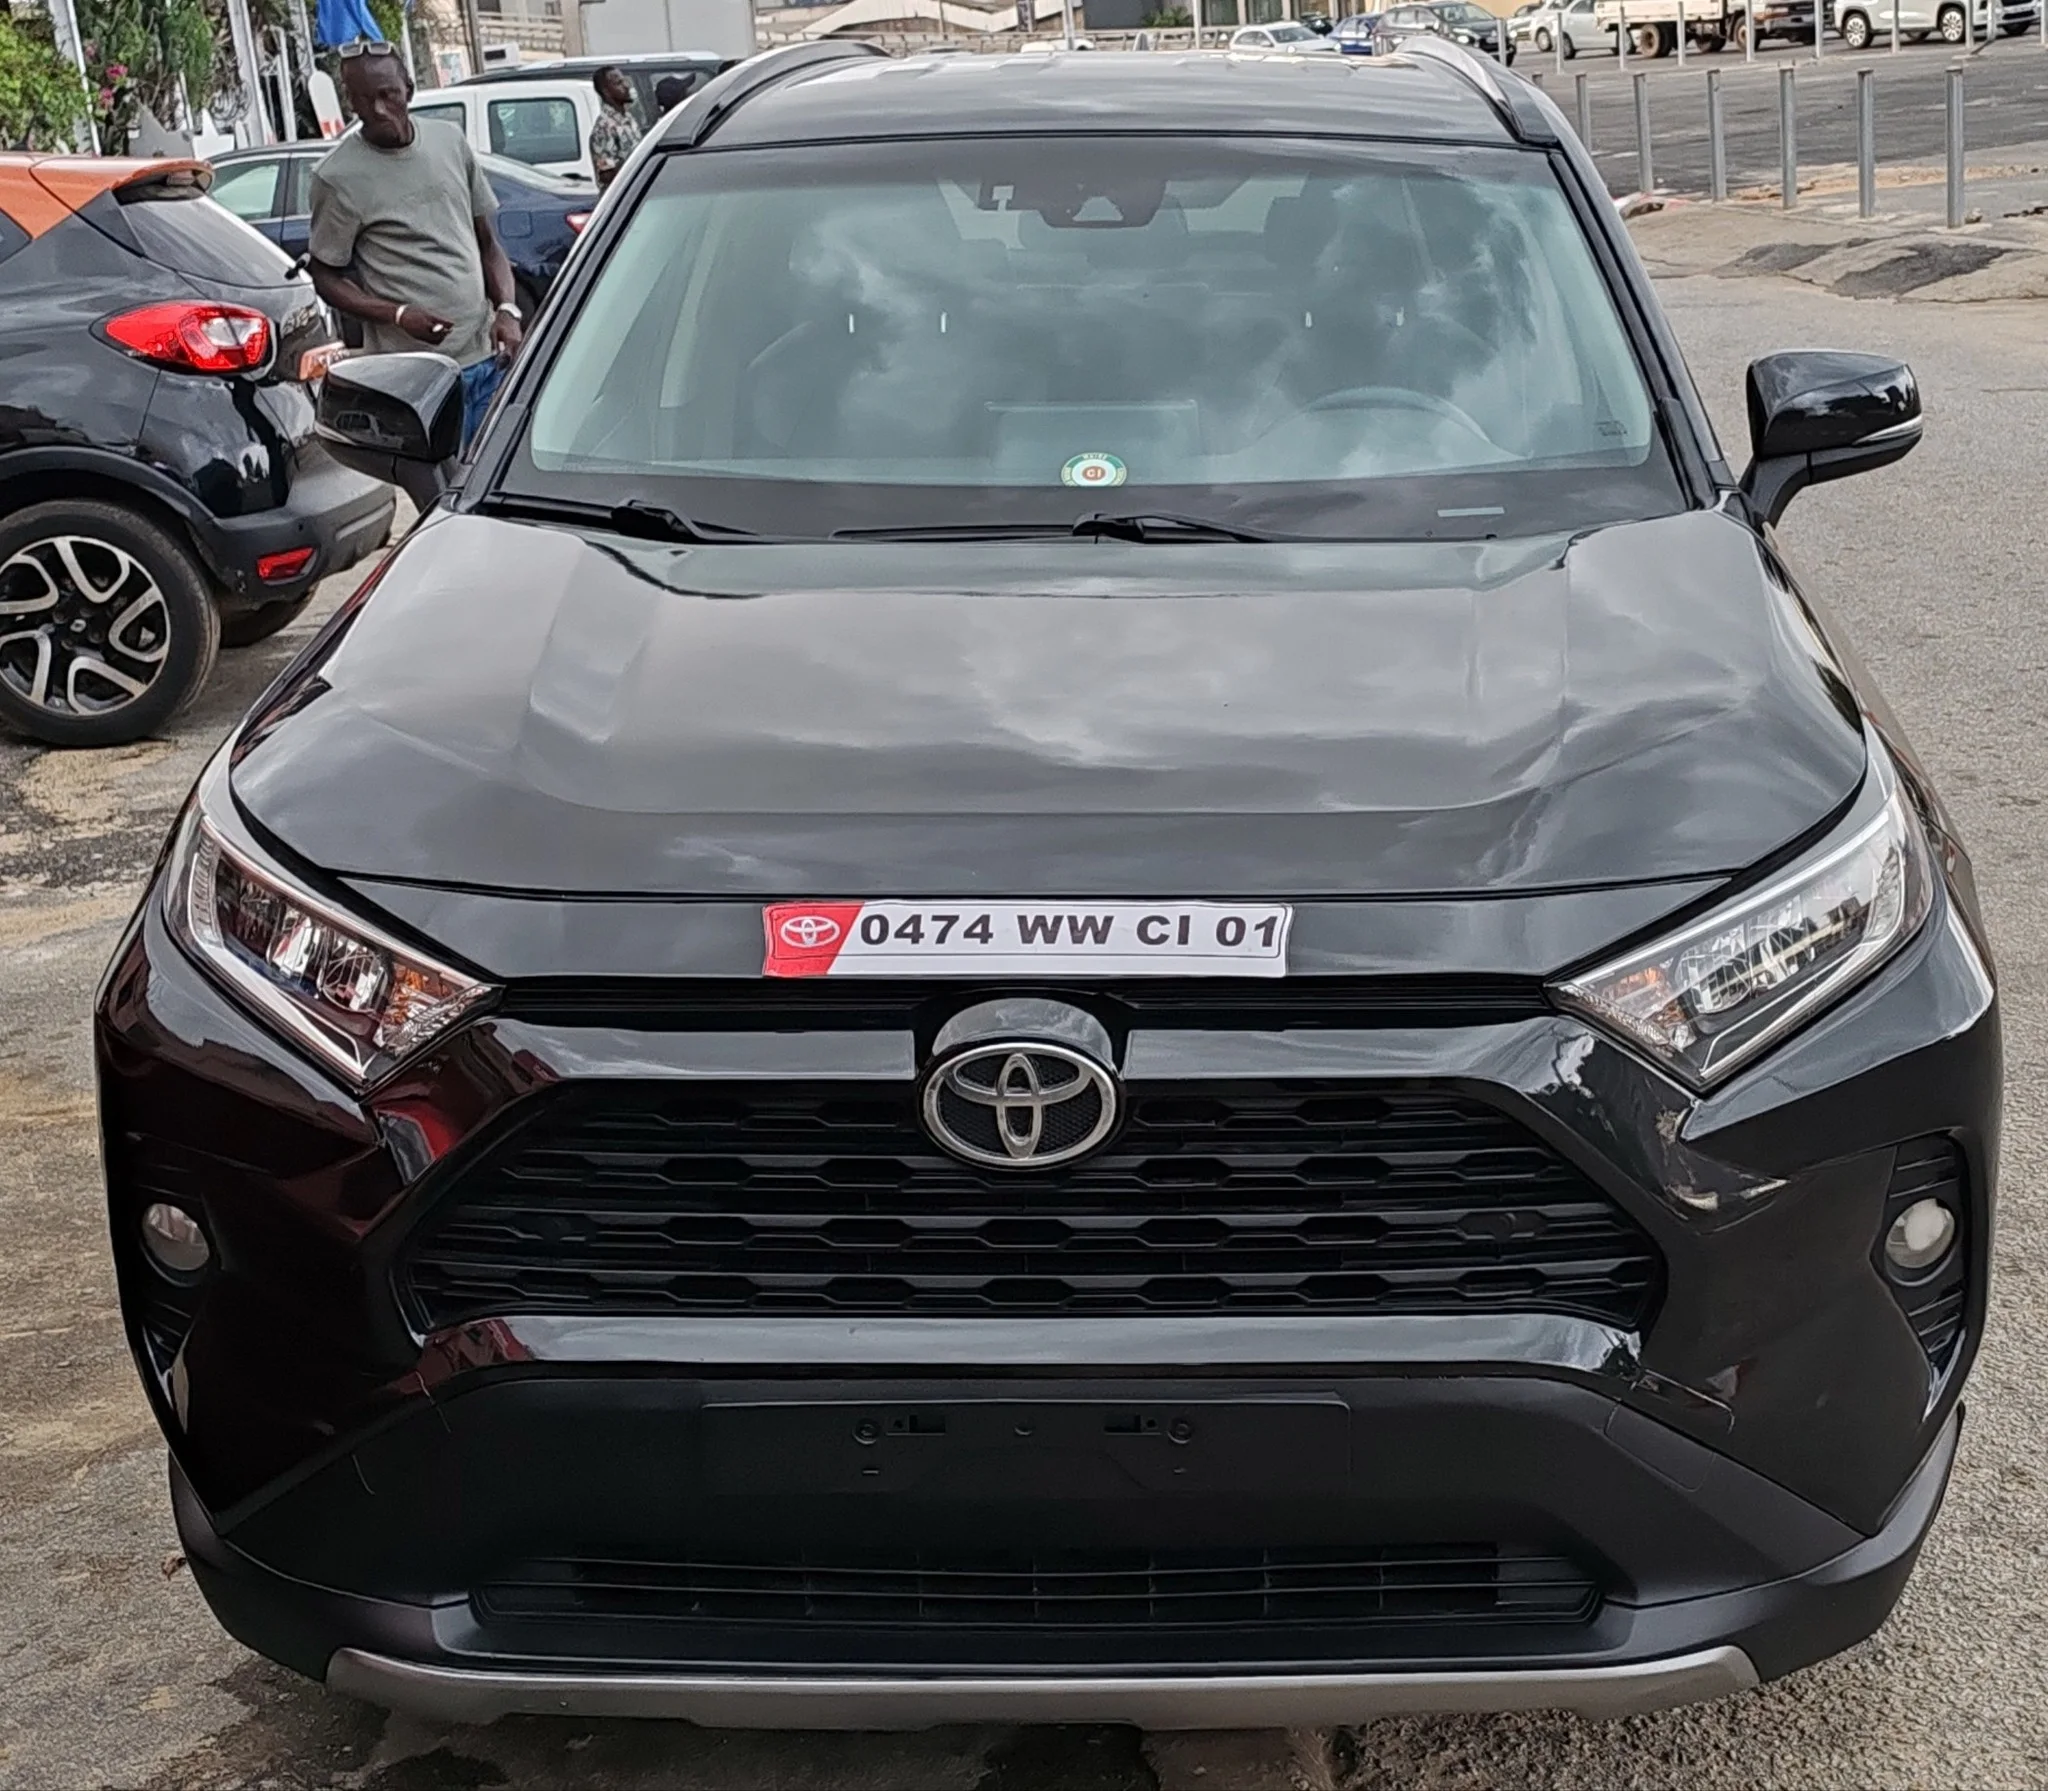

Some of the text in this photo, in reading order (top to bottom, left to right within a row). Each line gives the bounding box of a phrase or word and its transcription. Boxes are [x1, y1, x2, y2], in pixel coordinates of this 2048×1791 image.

[860, 914, 1278, 947] 0474 WW CI 01
